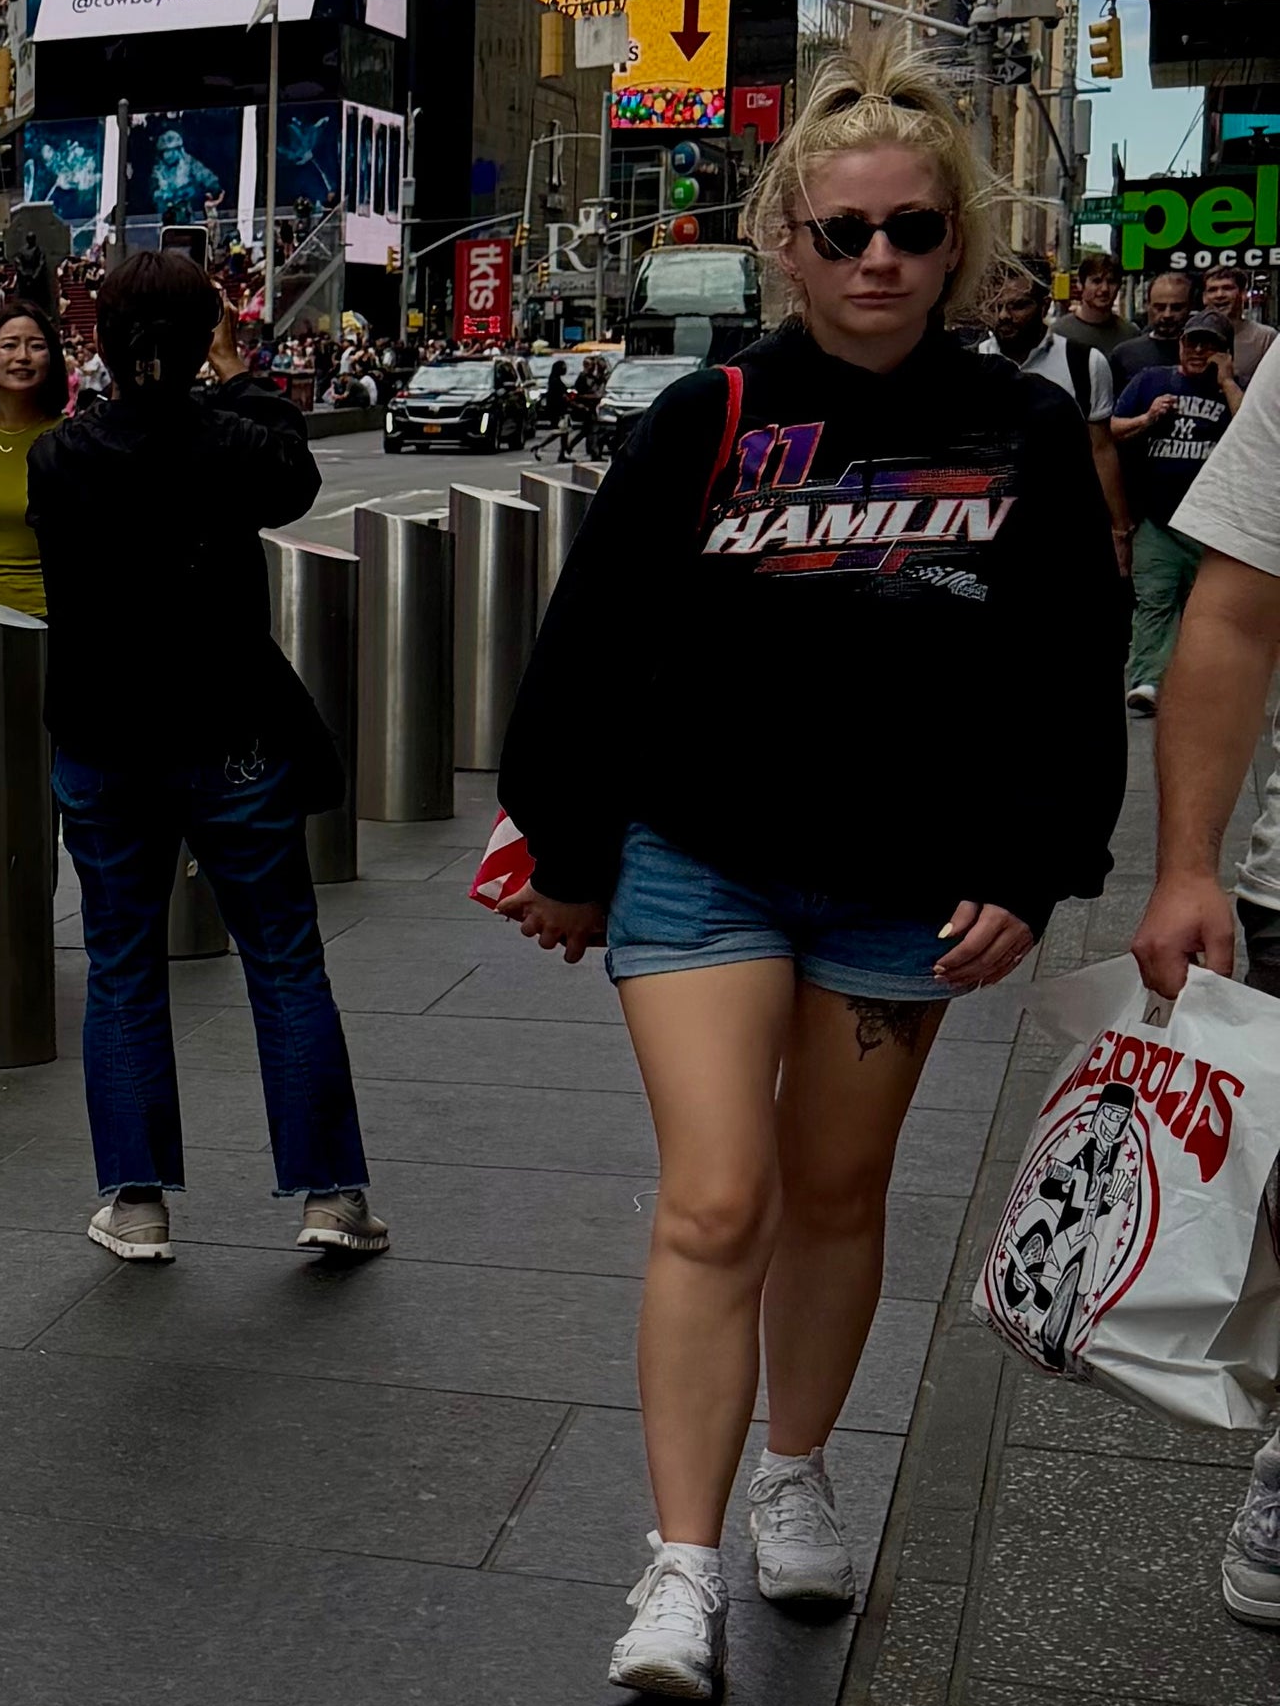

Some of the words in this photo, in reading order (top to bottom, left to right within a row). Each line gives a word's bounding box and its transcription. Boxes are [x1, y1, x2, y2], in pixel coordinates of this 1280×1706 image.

[468, 242, 505, 312] tkts
[1169, 247, 1280, 271] SOCCE
[1173, 394, 1226, 422] NKEE
[731, 420, 826, 498] 11
[700, 496, 1020, 555] HAMLIN
